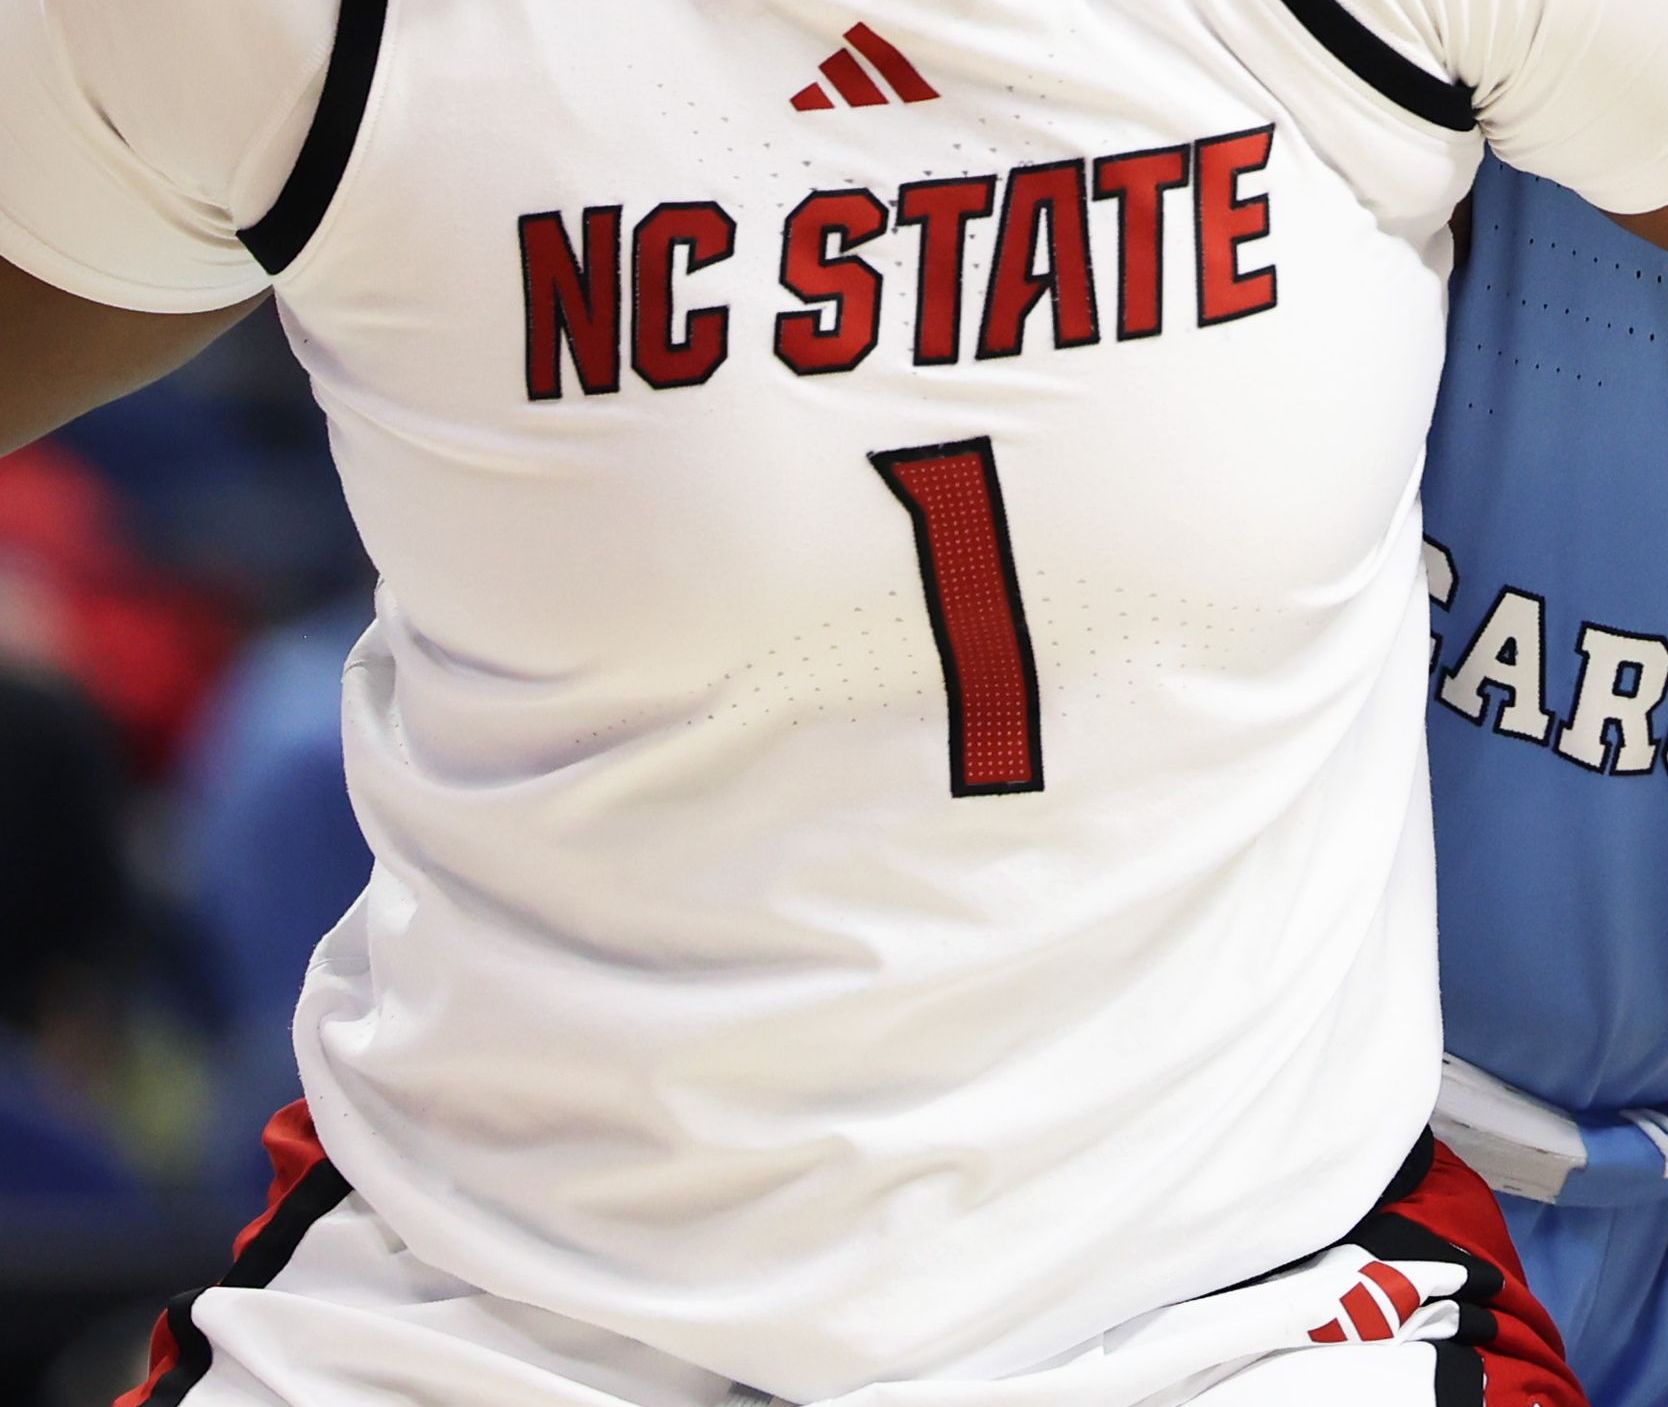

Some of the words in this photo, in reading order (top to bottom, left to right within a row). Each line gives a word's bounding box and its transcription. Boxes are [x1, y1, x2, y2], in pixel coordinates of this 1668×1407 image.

[518, 202, 736, 402] NC
[773, 122, 1276, 378] STATE
[866, 434, 1045, 799] 1
